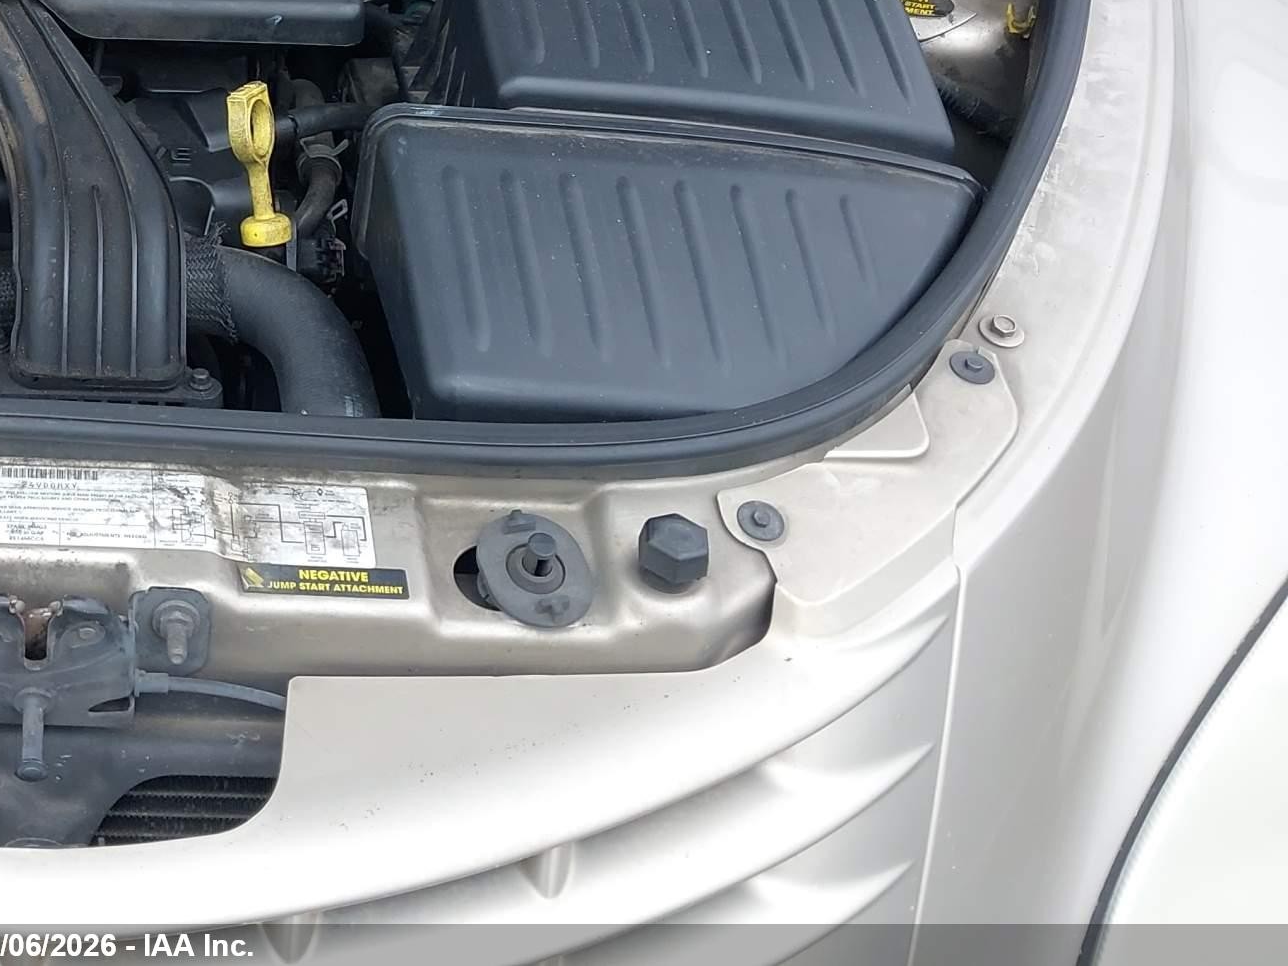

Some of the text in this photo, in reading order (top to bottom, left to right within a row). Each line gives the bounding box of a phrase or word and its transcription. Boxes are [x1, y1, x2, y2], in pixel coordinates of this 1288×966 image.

[904, 1, 936, 10] START
[298, 568, 369, 583] NEGATIVE
[268, 580, 404, 595] JUMP START ATTACHMENT
